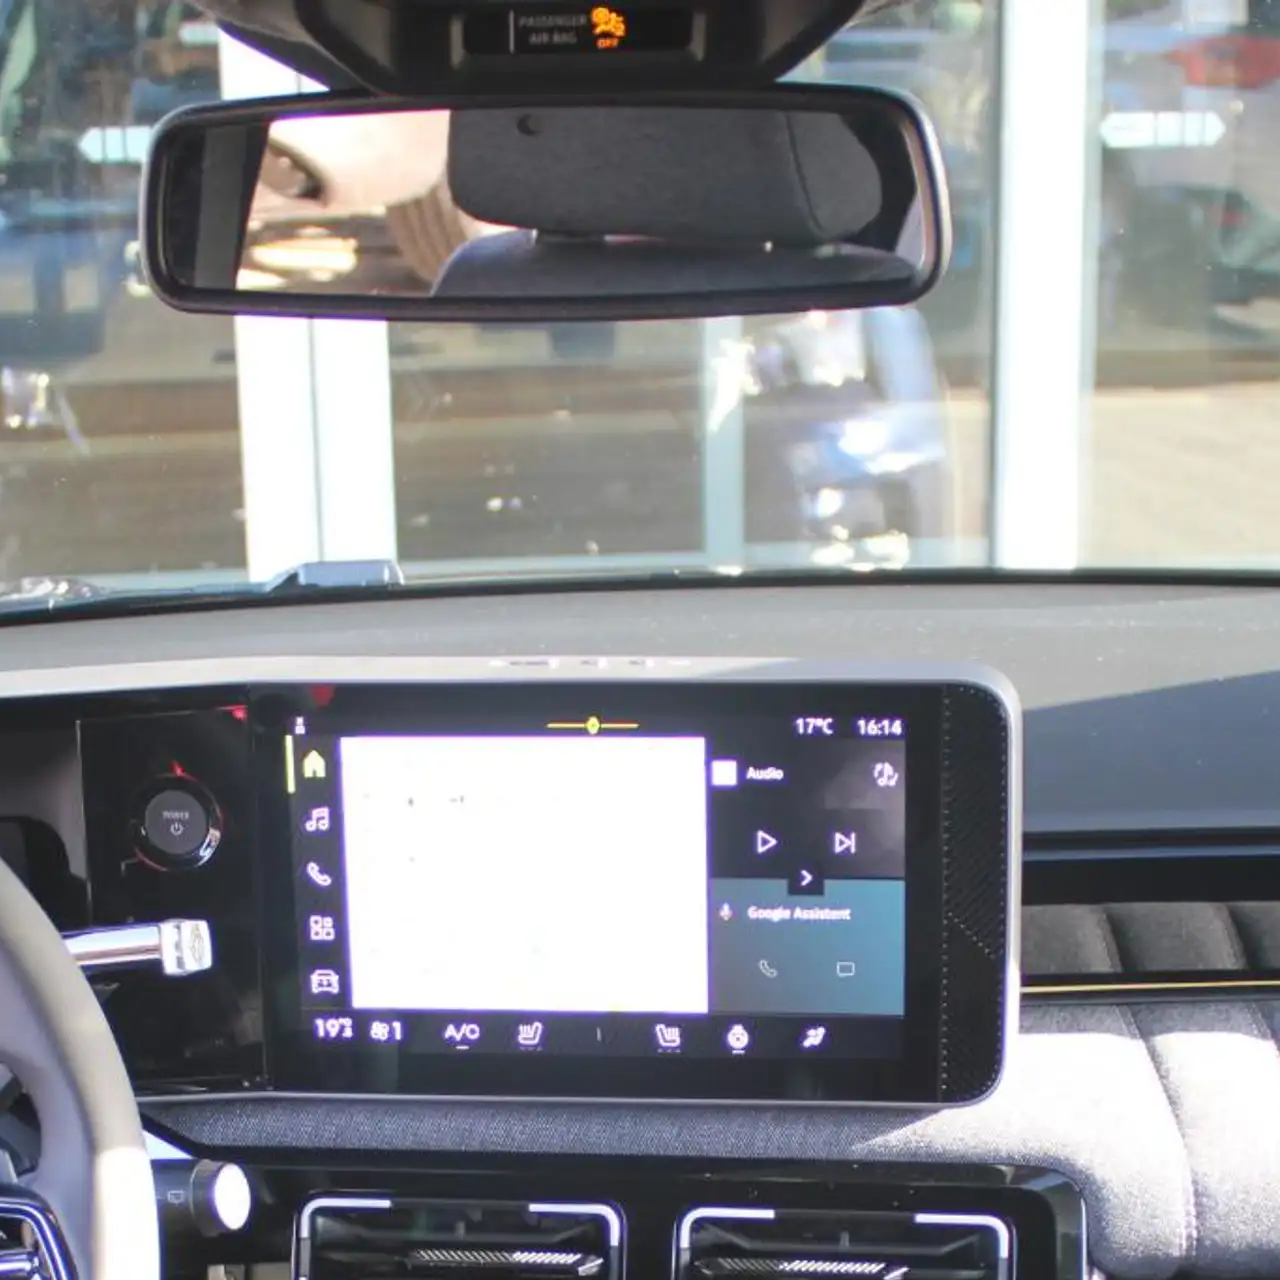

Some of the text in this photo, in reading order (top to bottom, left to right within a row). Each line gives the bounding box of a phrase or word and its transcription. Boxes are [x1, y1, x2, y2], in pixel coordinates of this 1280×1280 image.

[857, 719, 903, 736] 16:14
[746, 766, 785, 781] Audio
[747, 905, 791, 923] Google
